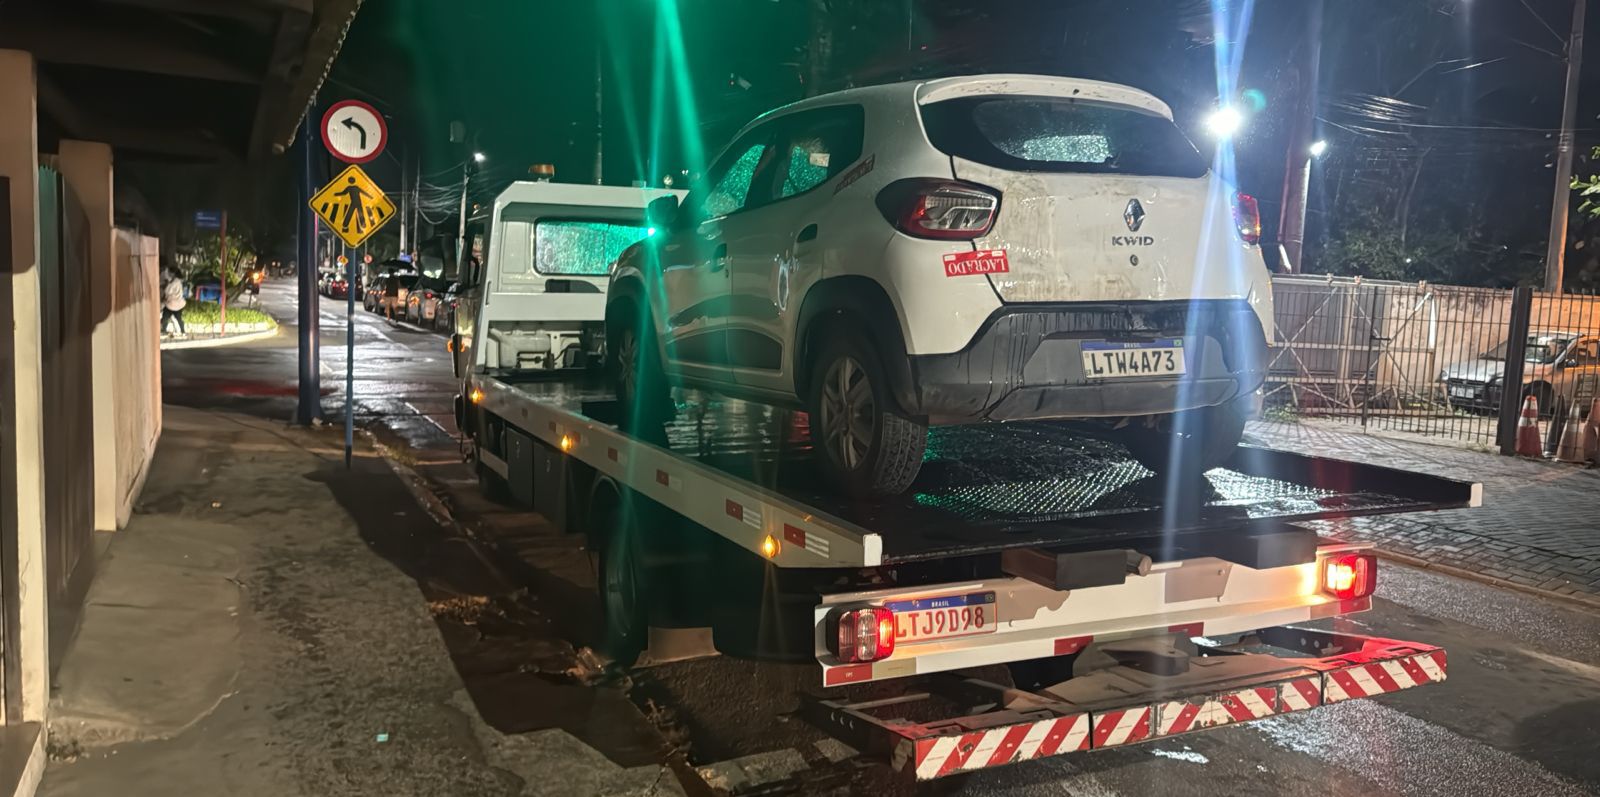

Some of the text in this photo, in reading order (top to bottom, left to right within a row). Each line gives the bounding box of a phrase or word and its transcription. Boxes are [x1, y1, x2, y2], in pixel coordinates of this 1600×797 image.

[1111, 236, 1154, 246] KWID
[948, 258, 1006, 275] LACRADO
[1091, 350, 1175, 375] LTW4A73
[931, 600, 949, 608] BRASIL
[894, 606, 985, 638] LTJ9D98
